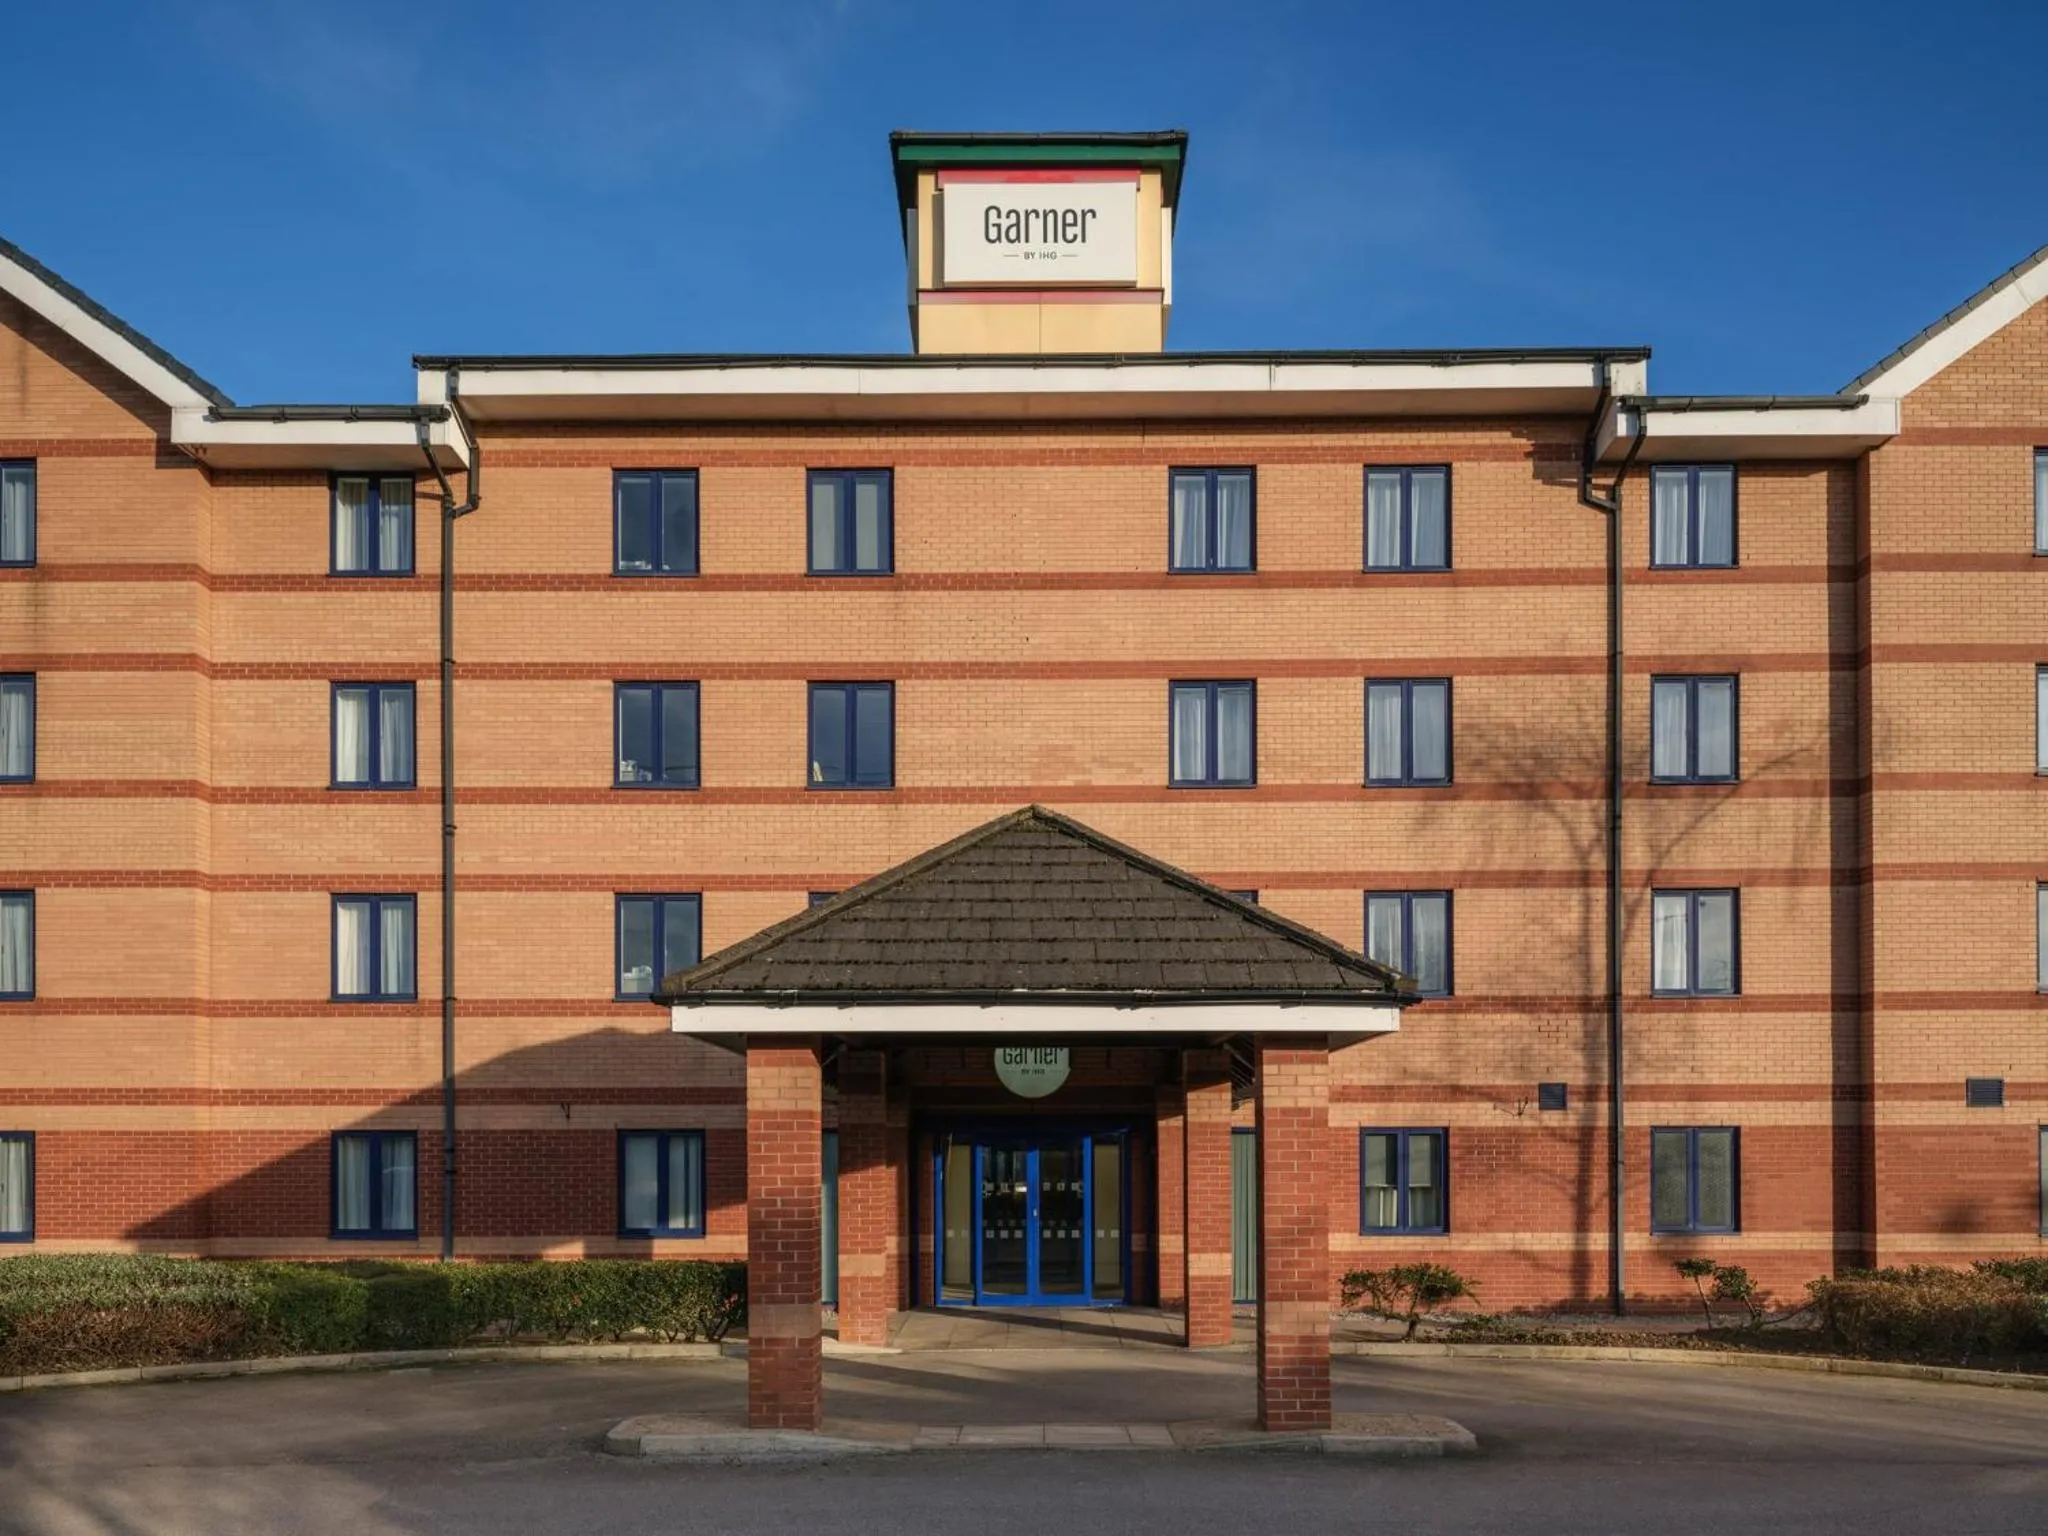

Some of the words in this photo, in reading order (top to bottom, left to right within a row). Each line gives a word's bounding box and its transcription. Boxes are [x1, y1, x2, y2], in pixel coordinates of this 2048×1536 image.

[984, 205, 1097, 244] Garner
[1024, 251, 1035, 260] BY
[1039, 251, 1057, 260] IHG
